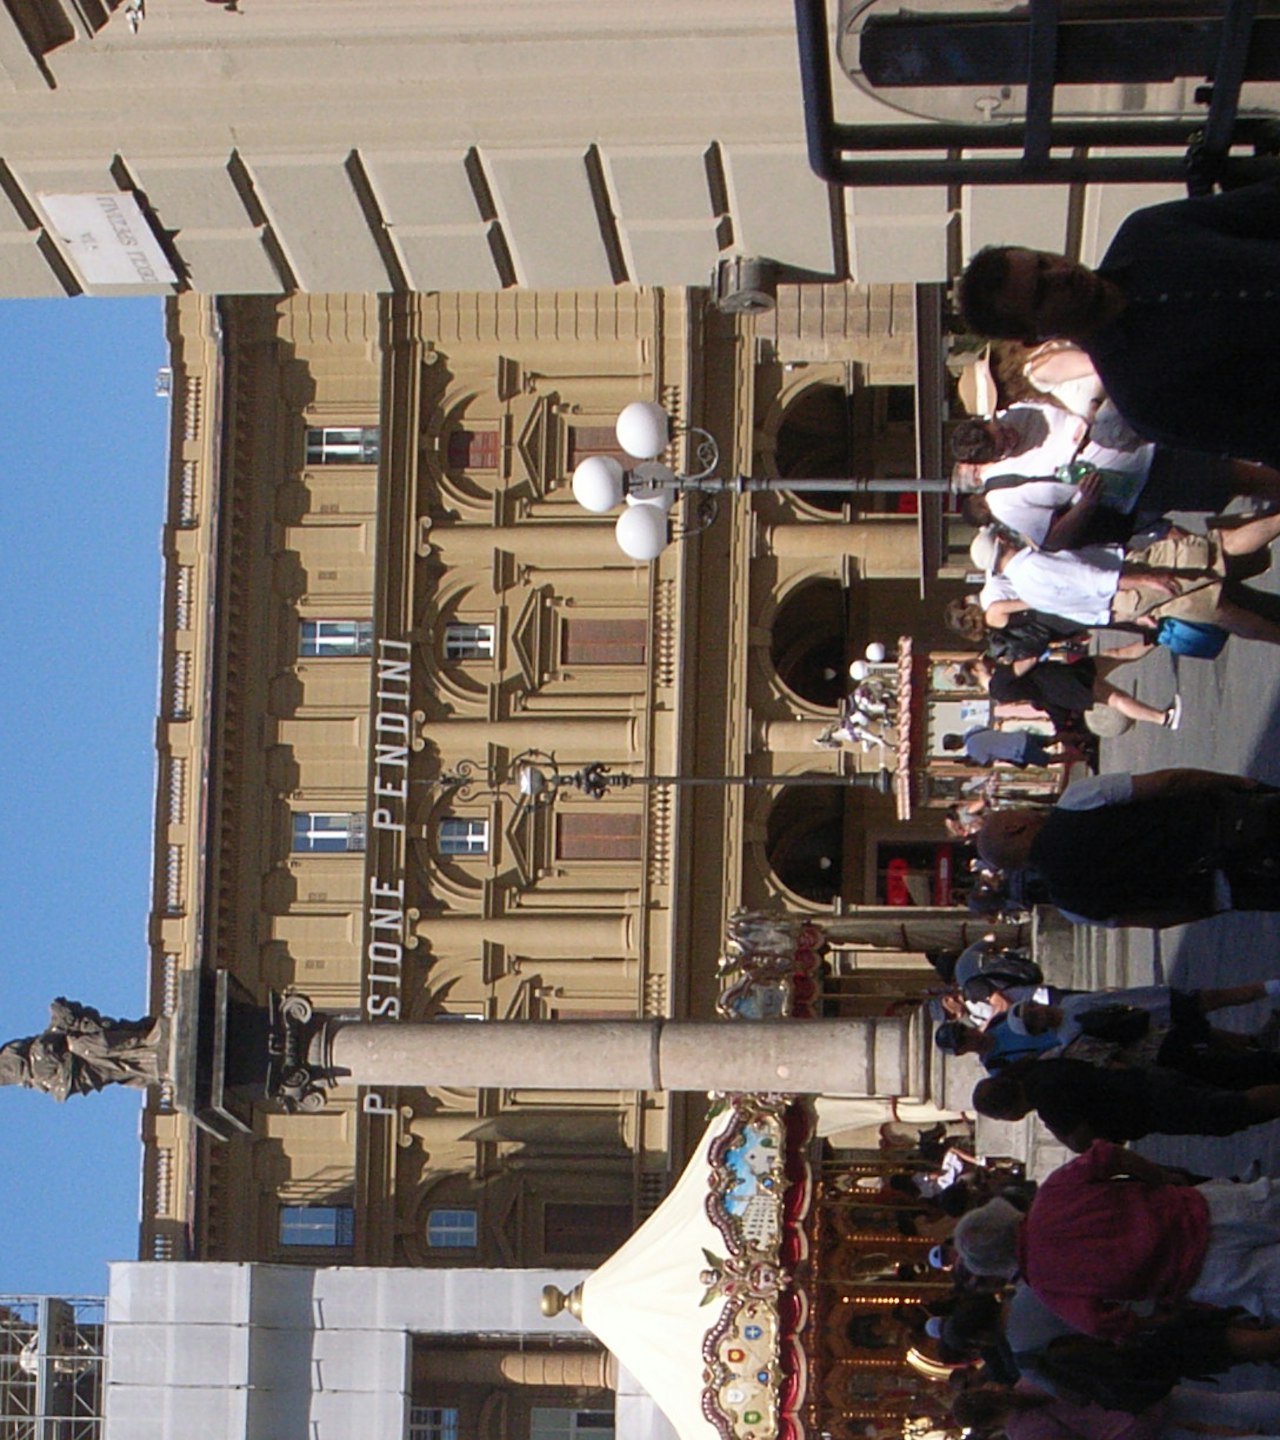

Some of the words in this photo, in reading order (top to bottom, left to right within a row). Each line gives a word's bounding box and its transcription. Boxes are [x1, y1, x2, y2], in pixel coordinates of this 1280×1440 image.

[96, 197, 138, 246] SPEZIALI
[126, 251, 158, 282] DEGLI
[372, 638, 412, 832] PENDINI
[364, 876, 404, 1116] PSIONE
